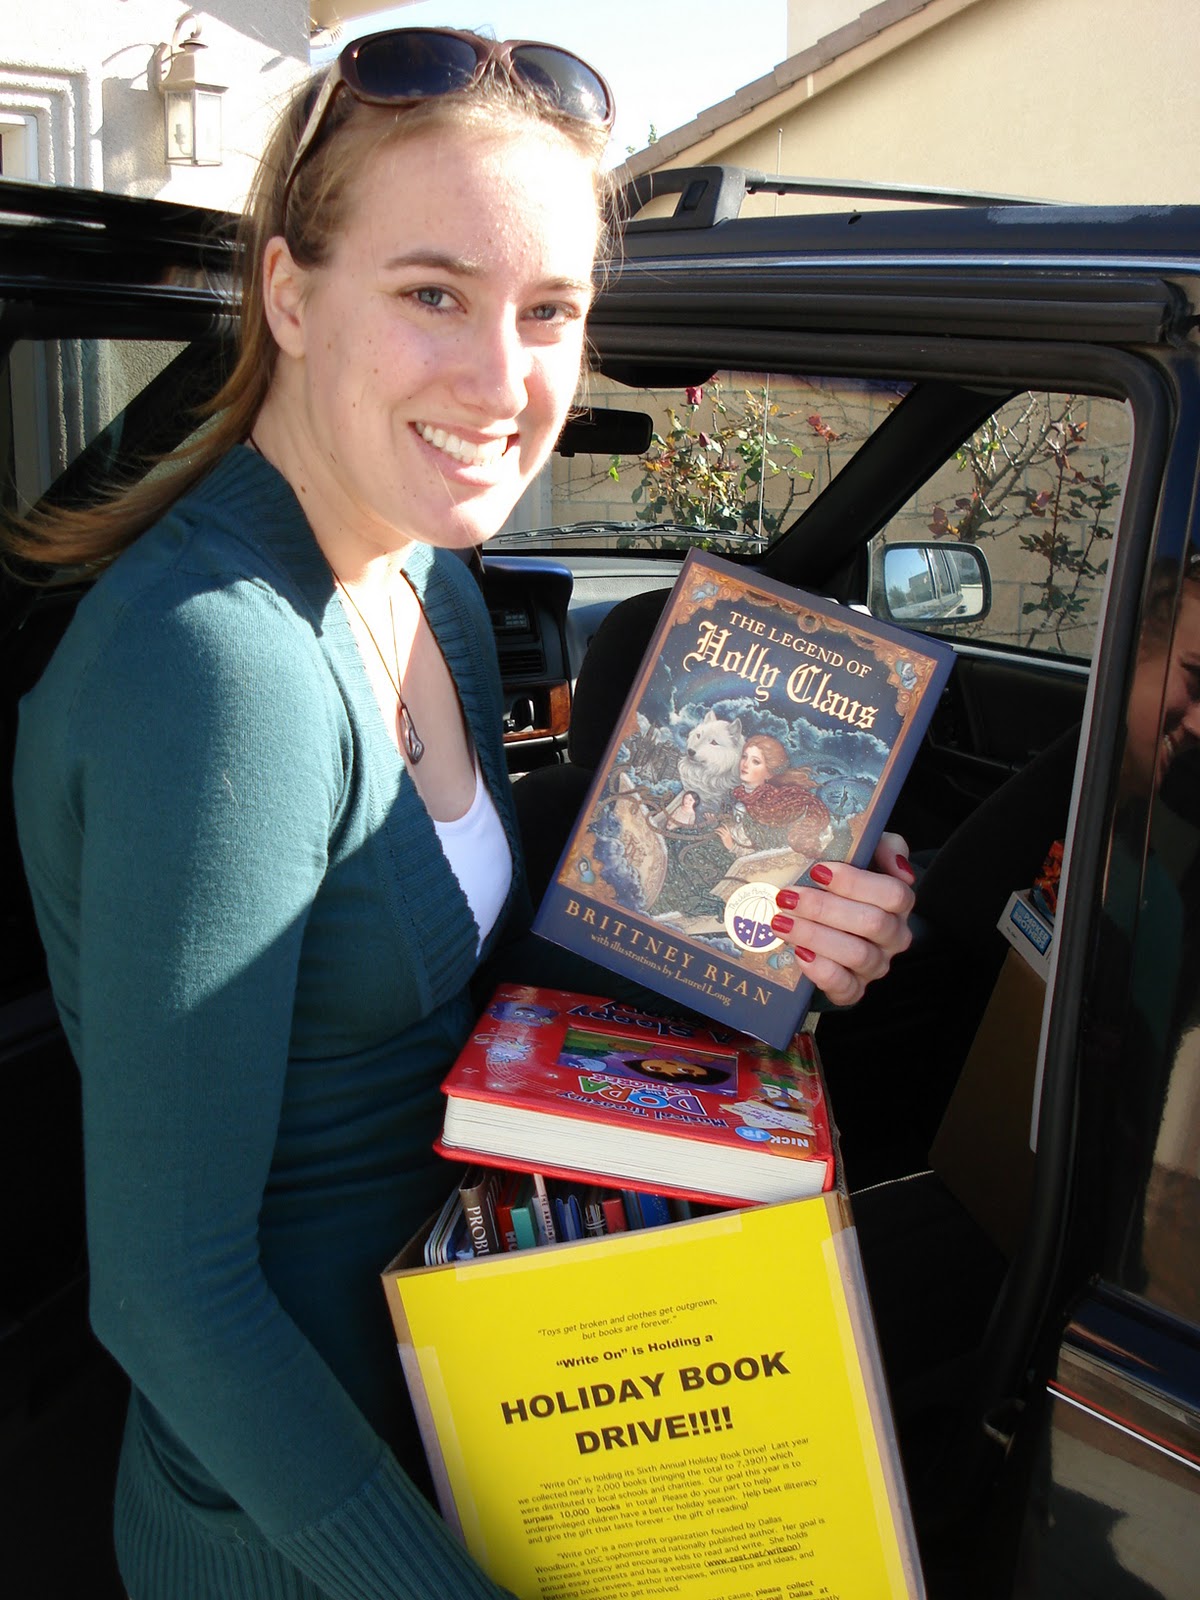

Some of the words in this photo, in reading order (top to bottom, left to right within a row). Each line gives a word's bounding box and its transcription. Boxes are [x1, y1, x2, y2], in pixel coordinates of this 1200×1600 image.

[729, 611, 764, 636] THE
[767, 628, 843, 667] LEGEND
[846, 660, 872, 678] OF
[682, 621, 781, 702] Holly
[786, 663, 880, 729] Claus
[564, 899, 694, 969] BRITTNEY
[703, 963, 773, 1006] RYAN
[591, 933, 609, 946] with
[610, 942, 661, 971] illustrations
[662, 965, 674, 977] by
[674, 970, 706, 991] Laurel
[706, 984, 732, 1006] Long
[567, 1004, 694, 1038] Sleepy
[556, 1091, 649, 1117] Treasury
[578, 1076, 707, 1116] DORA
[592, 1073, 693, 1096] EXPLORER
[654, 1110, 729, 1128] Musical
[770, 1135, 809, 1148] NICK
[563, 1323, 577, 1334] get
[579, 1317, 607, 1329] broken
[609, 1314, 624, 1323] and
[627, 1308, 656, 1320] clothes
[658, 1305, 673, 1316] get
[581, 1330, 596, 1339] but
[598, 1325, 623, 1336] books
[632, 1345, 643, 1355] is
[647, 1334, 701, 1354] Holding
[501, 1373, 665, 1425] HOLIDAY
[679, 1351, 791, 1392] BOOK
[575, 1406, 734, 1455] DRIVE!!!!
[531, 1491, 567, 1502] collected
[569, 1487, 593, 1497] nearly
[595, 1482, 620, 1492] 2,000
[622, 1478, 647, 1487] books
[649, 1471, 685, 1484] (bringing
[687, 1468, 701, 1476] the
[703, 1465, 722, 1473] total
[769, 1451, 793, 1461] which
[592, 1471, 622, 1483] holding
[624, 1468, 634, 1476] its
[636, 1465, 657, 1473] Sixth
[659, 1460, 686, 1470] Annual
[688, 1454, 717, 1466] Holiday
[720, 1450, 740, 1459] Book
[771, 1440, 789, 1449] Last
[791, 1437, 809, 1447] year
[523, 1515, 553, 1525] surpass
[560, 1508, 590, 1519] 10,000
[595, 1503, 620, 1512] books
[662, 1492, 687, 1501] Please
[703, 1486, 721, 1496] your
[722, 1481, 740, 1492] part
[753, 1475, 771, 1486] help
[525, 1519, 585, 1536] underprivileged
[587, 1514, 619, 1524] children
[620, 1510, 639, 1518] have
[648, 1505, 673, 1514] better
[675, 1499, 704, 1511] holiday
[742, 1489, 761, 1499] Help
[762, 1485, 781, 1493] beat
[783, 1478, 818, 1491] illiteracy
[541, 1499, 584, 1510] distributed
[597, 1493, 616, 1501] local
[618, 1488, 648, 1498] schools
[650, 1484, 665, 1493] and
[708, 1474, 722, 1482] Our
[725, 1470, 742, 1481] goal
[745, 1467, 760, 1476] this
[762, 1465, 780, 1474] year
[528, 1535, 542, 1544] and
[544, 1532, 561, 1543] give
[563, 1530, 576, 1538] the
[578, 1527, 593, 1537] gift
[595, 1524, 611, 1533] that
[614, 1522, 633, 1530] lasts
[635, 1517, 664, 1526] forever
[673, 1512, 687, 1520] the
[688, 1509, 703, 1519] gift
[617, 1538, 657, 1551] non-profit
[659, 1529, 708, 1544] organization
[710, 1523, 743, 1534] founded
[745, 1520, 755, 1530] by
[758, 1516, 782, 1525] Dallas
